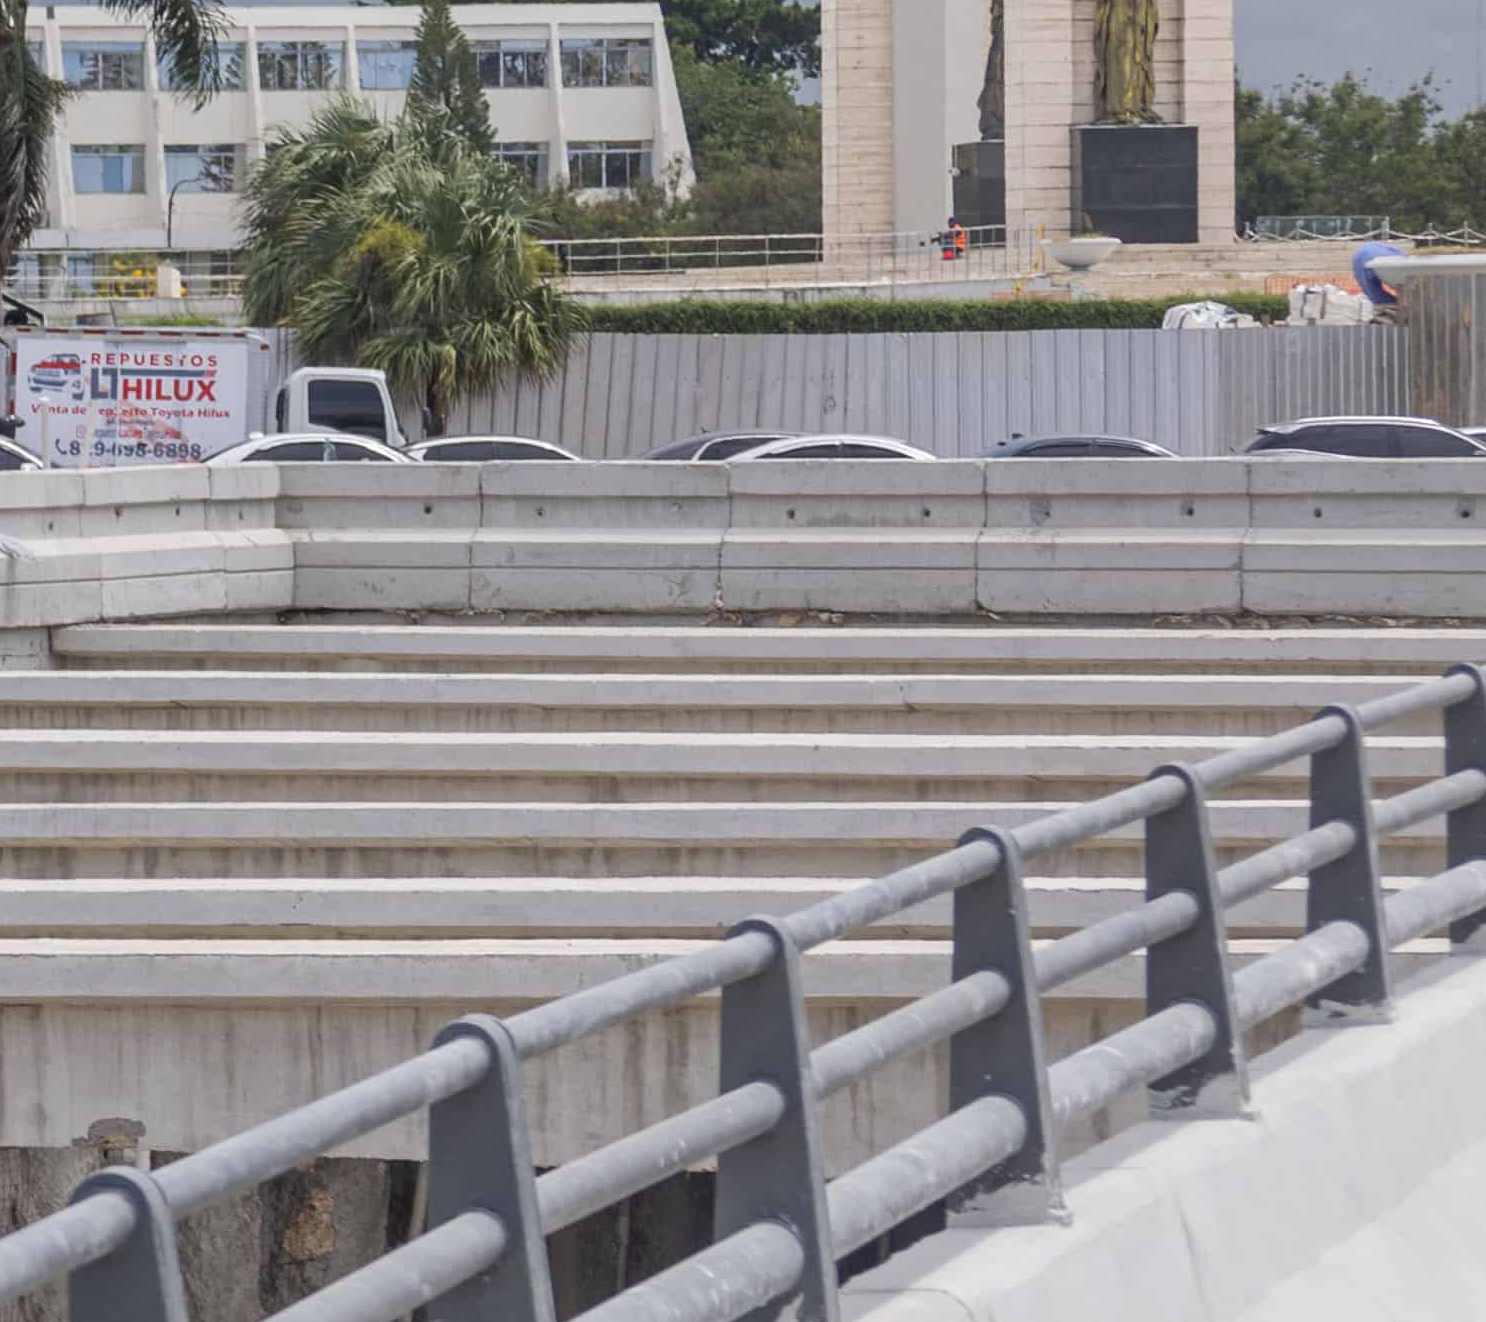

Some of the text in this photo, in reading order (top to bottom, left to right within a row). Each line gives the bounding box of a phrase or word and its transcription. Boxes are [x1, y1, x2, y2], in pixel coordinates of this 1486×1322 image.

[122, 378, 217, 402] HILUX
[30, 404, 69, 415] Vnta
[71, 406, 87, 415] de
[151, 408, 194, 419] Toyota
